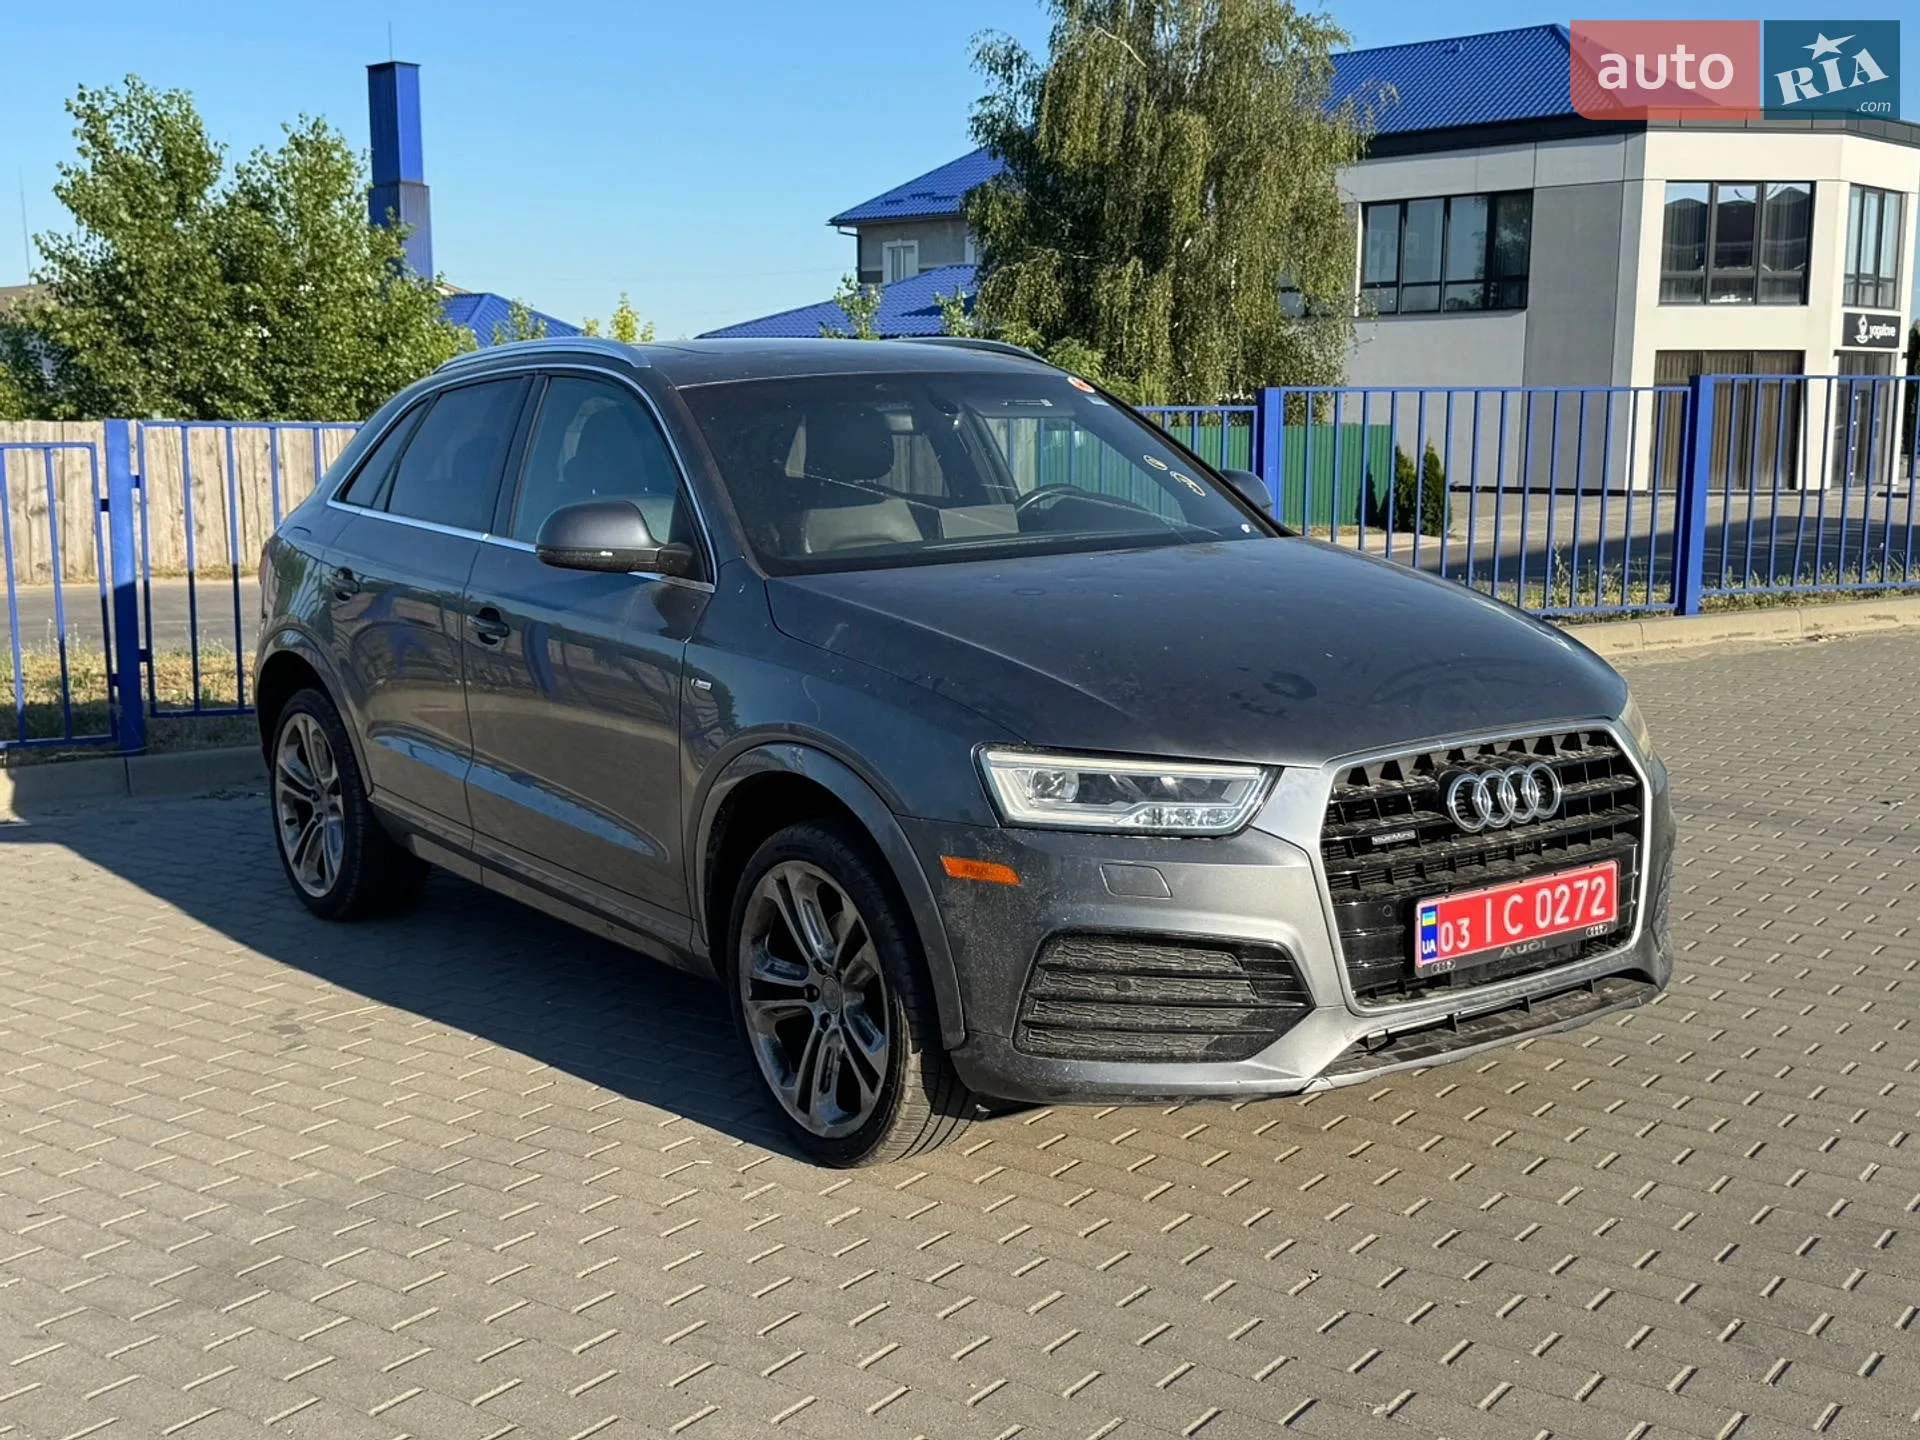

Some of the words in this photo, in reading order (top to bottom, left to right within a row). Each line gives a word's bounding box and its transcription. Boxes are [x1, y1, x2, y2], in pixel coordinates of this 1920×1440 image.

[1440, 917, 1470, 952] 03
[1535, 876, 1606, 929] 0272
[1422, 939, 1436, 954] UA
[1500, 939, 1547, 959] Audi
